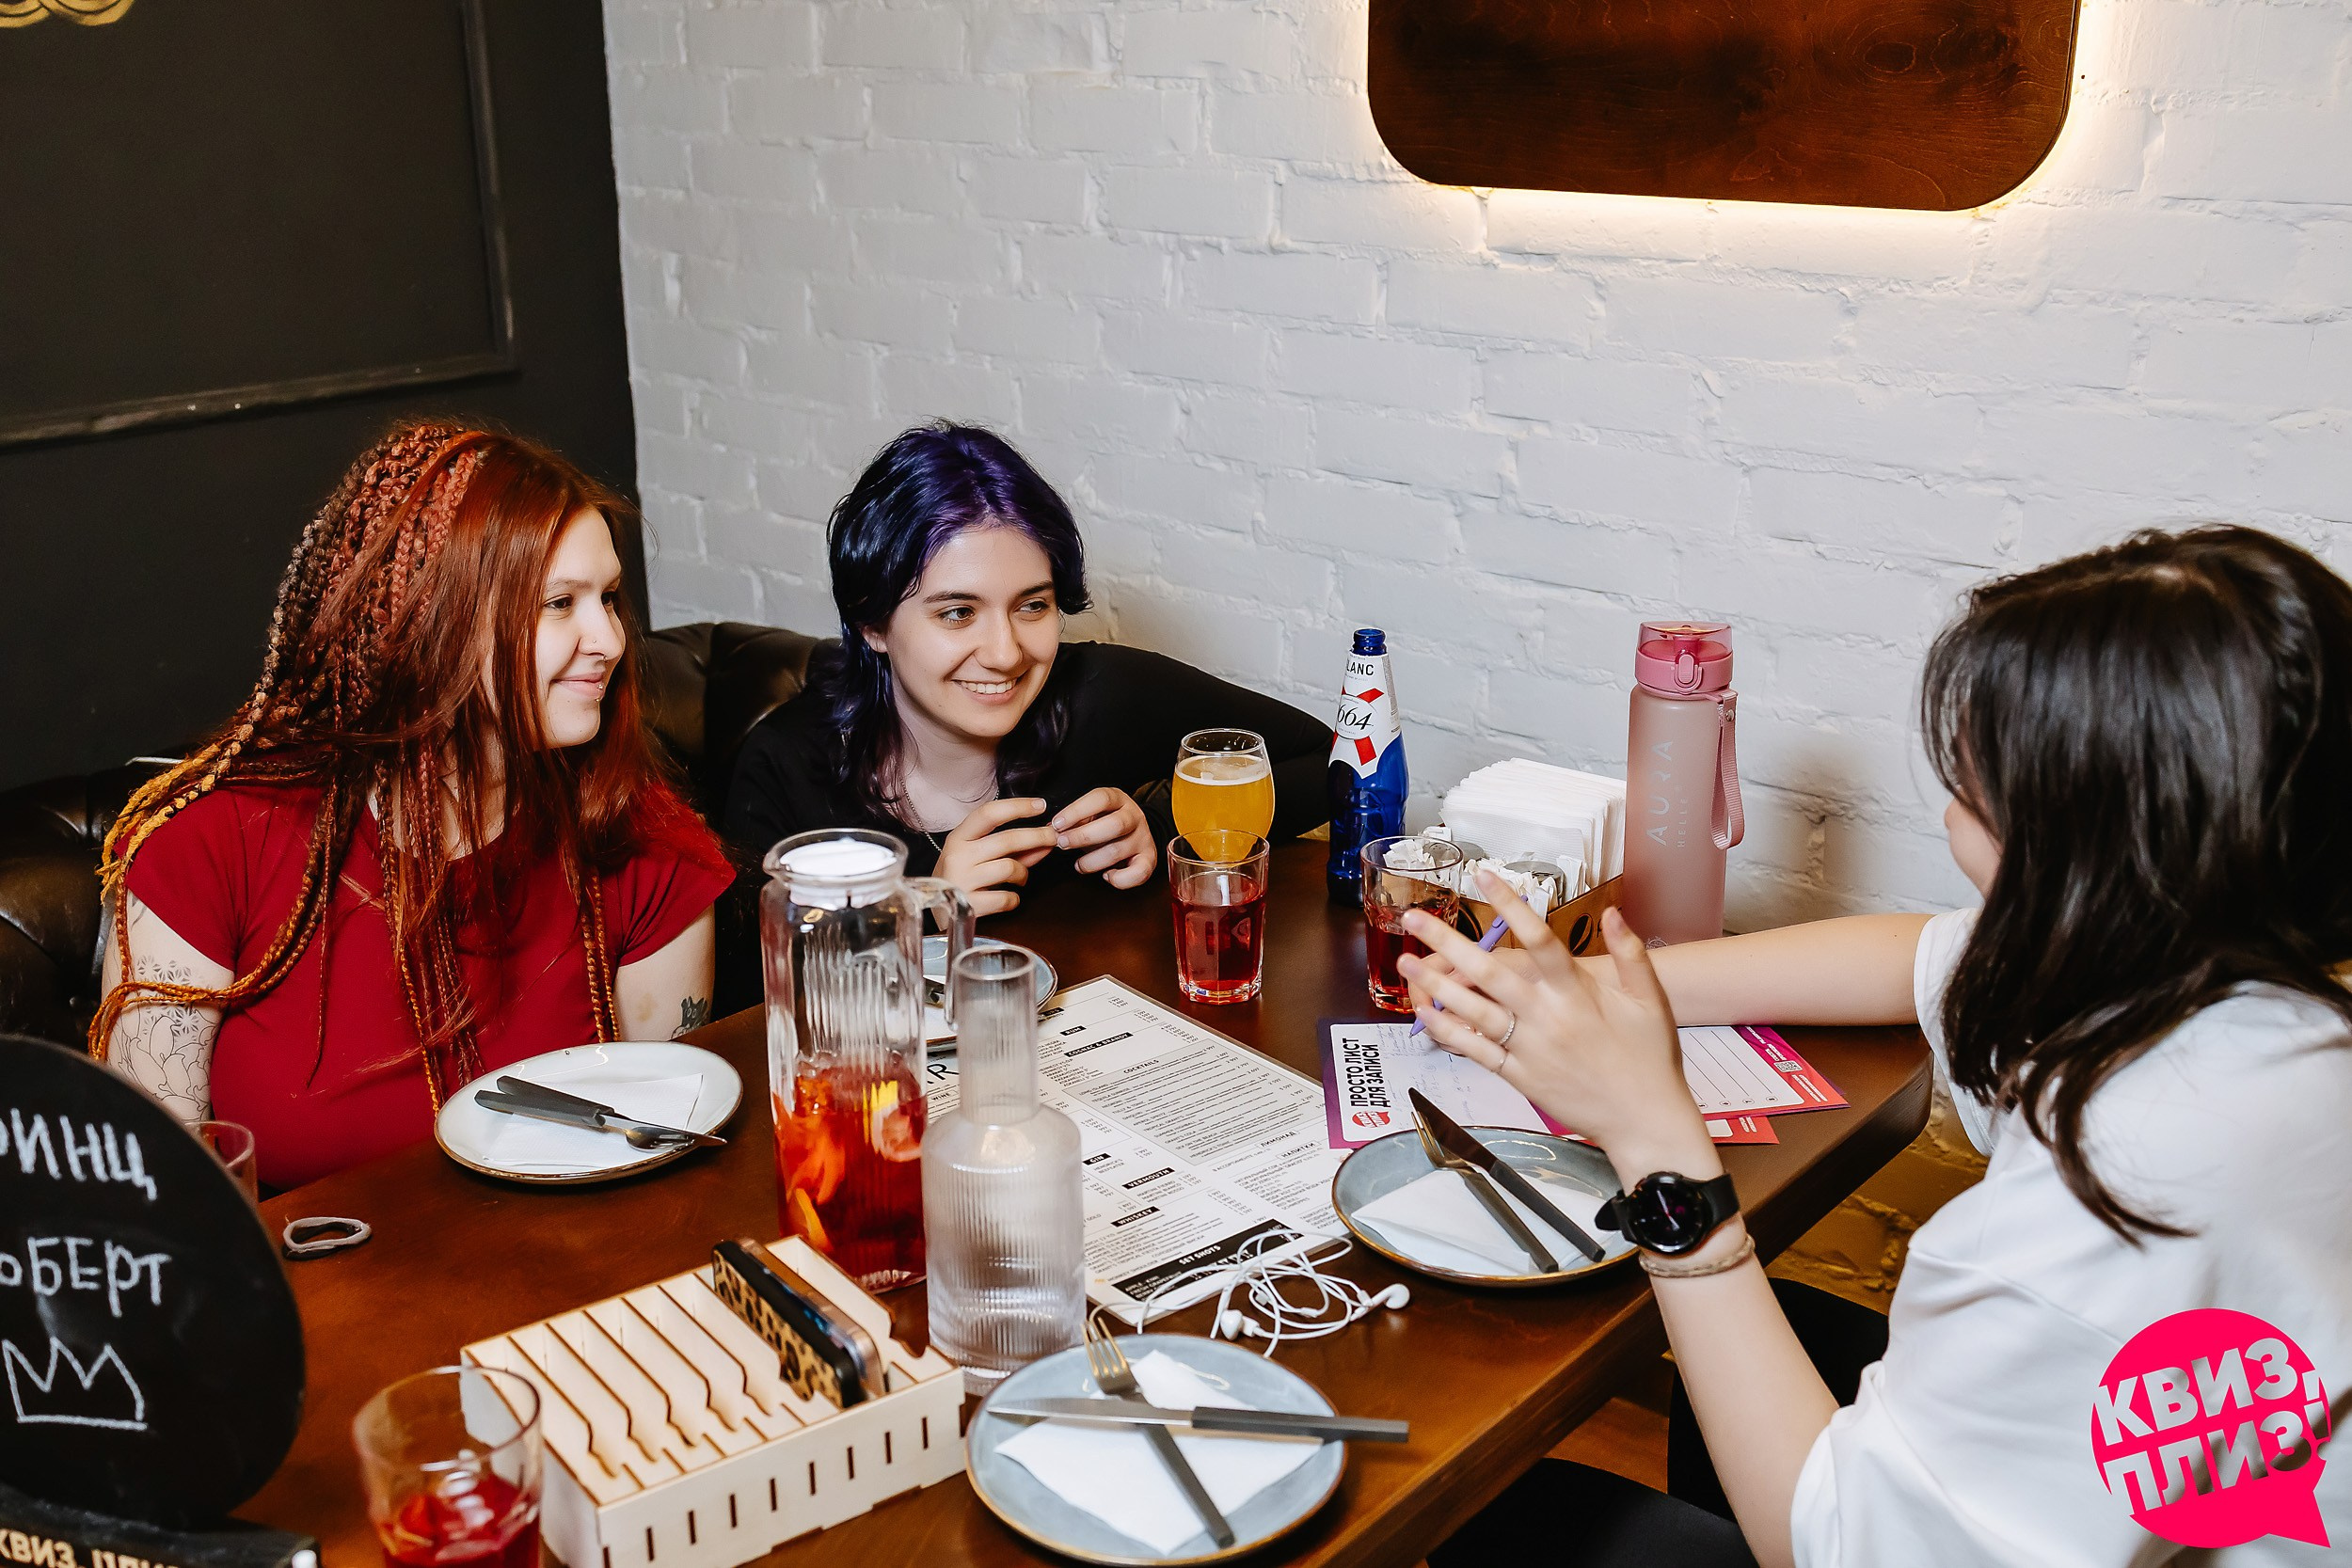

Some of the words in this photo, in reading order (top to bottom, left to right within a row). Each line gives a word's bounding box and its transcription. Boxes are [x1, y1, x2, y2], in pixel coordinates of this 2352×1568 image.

[1347, 659, 1374, 675] LANC
[1338, 705, 1375, 730] 664
[1646, 741, 1673, 846] AURA
[1069, 1044, 1095, 1056] COGNAC
[1102, 1033, 1129, 1044] BRANDY
[1343, 1038, 1362, 1064] ЛИСТ
[1123, 1059, 1159, 1073] COCKTAILS
[1361, 1044, 1384, 1085] ЗАПИСИ
[1346, 1067, 1369, 1107] ПРОСТО
[1368, 1087, 1391, 1108] ДЛЯ
[1260, 1132, 1295, 1147] ЛИМОНАД
[1280, 1143, 1315, 1157] НАПИТКИ
[0, 1108, 158, 1201] ИНЦ
[1089, 1155, 1104, 1164] GIN
[1128, 1170, 1168, 1186] VERMOUTH
[1118, 1209, 1152, 1225] WHISKEY
[1179, 1256, 1195, 1265] SET
[1195, 1245, 1221, 1259] SHOTS
[0, 1236, 172, 1318] ОБЕРТ
